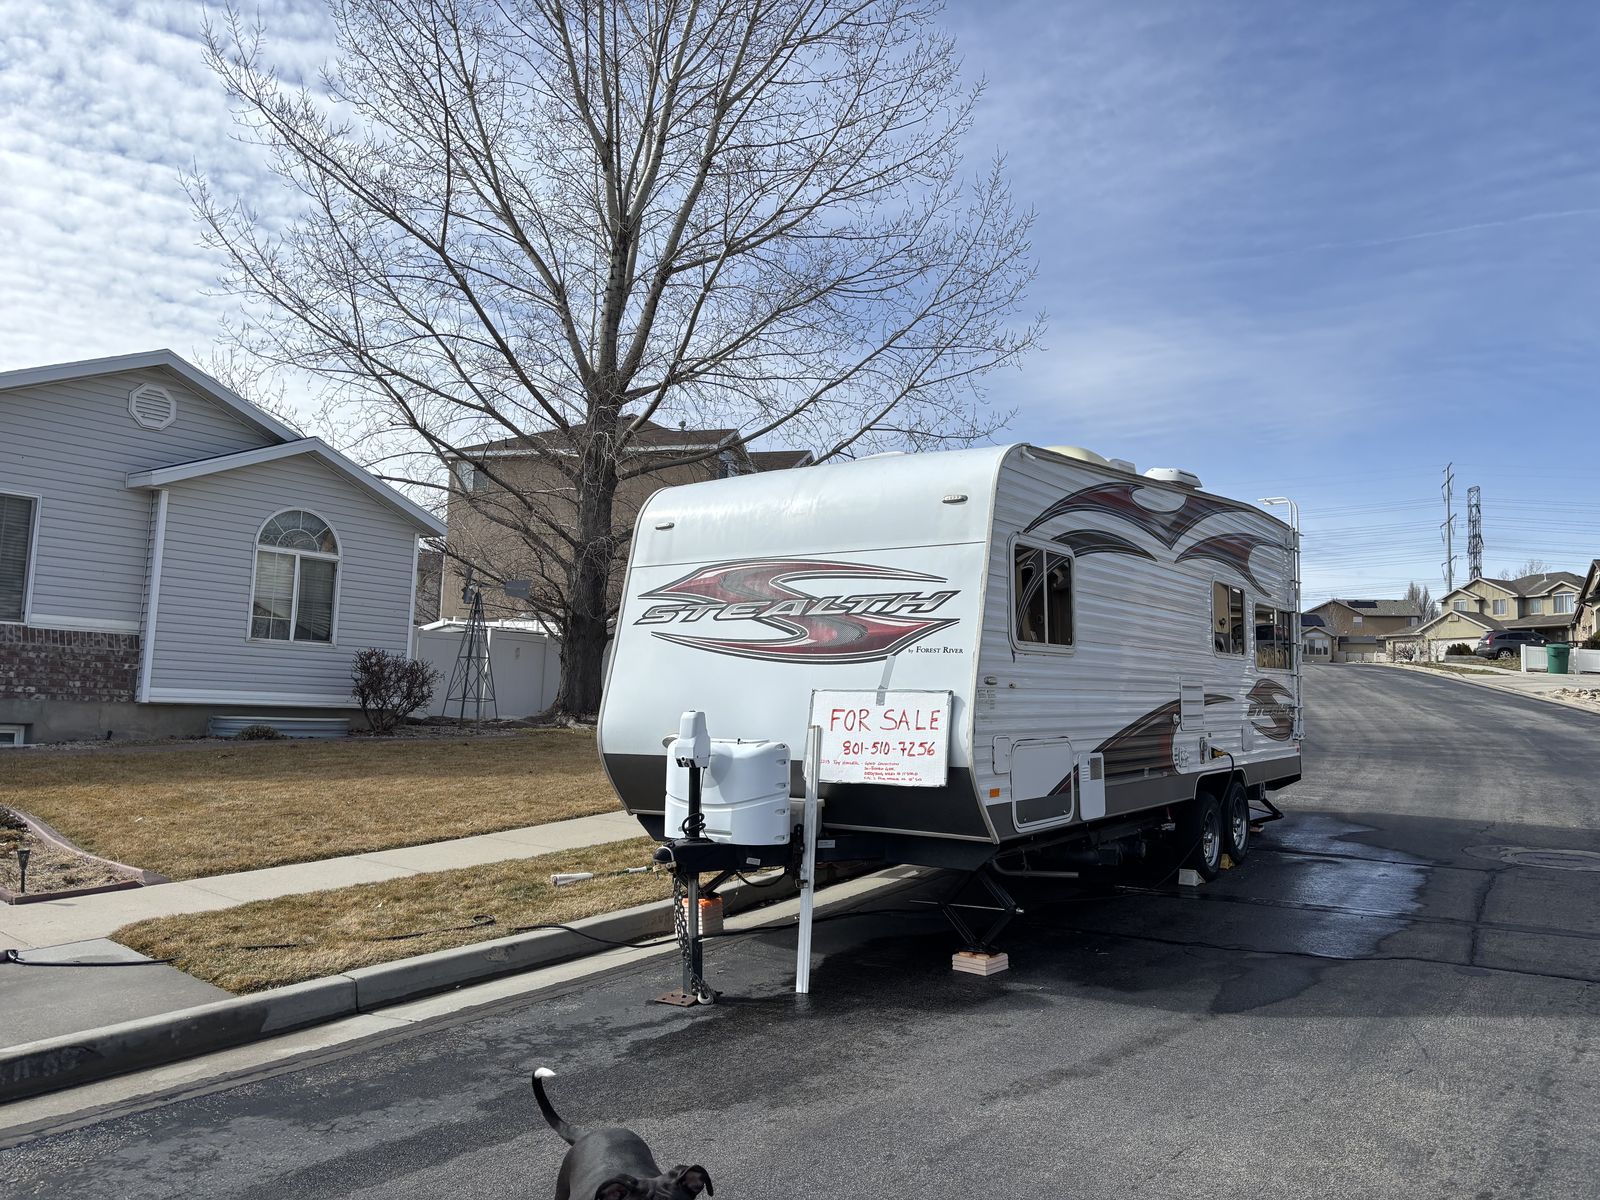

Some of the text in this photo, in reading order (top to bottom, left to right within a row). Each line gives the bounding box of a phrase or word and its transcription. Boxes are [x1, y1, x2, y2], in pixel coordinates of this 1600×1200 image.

[633, 590, 962, 626] STEALTH
[916, 645, 941, 654] FOREST
[942, 646, 964, 654] RIVER
[830, 708, 941, 732] FOR SALE
[842, 740, 936, 757] 801-510-7256
